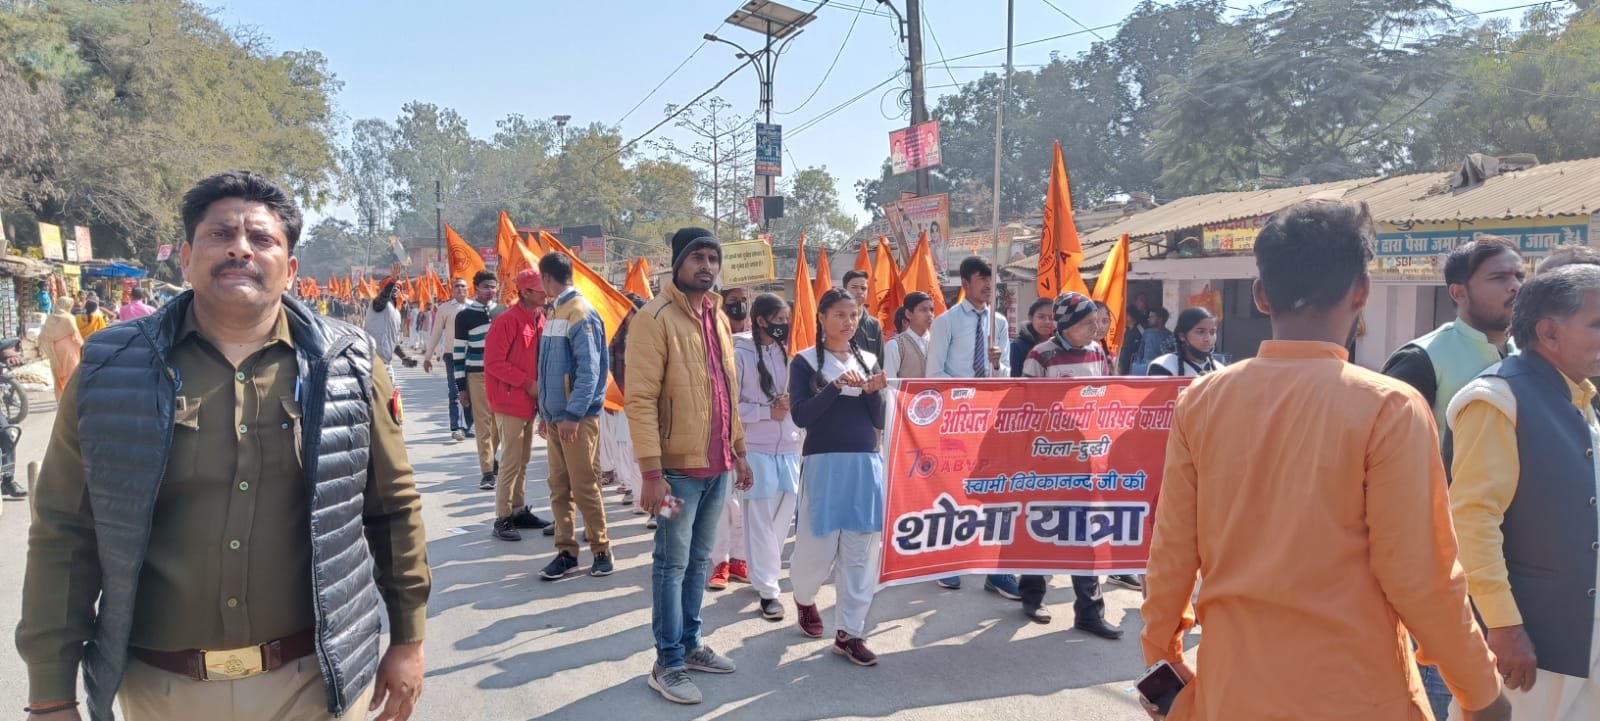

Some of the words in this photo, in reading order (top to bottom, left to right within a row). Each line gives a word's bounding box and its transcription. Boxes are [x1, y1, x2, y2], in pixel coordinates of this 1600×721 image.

[1405, 234, 1429, 252] पैसा
[1431, 238, 1457, 251] जमा
[1525, 233, 1560, 249] जाता
[1395, 256, 1412, 267] SBI
[941, 404, 991, 433] अखिल
[995, 403, 1046, 431] भारतीय
[1098, 401, 1137, 428] परिषद
[1140, 401, 1175, 429] काशी
[965, 475, 1007, 493] स्वामी
[1010, 473, 1092, 491] विवेकानन्द
[1097, 471, 1118, 490] जी
[1122, 470, 1146, 490] की
[897, 496, 1018, 550] शोभा
[1028, 505, 1146, 543] यात्रा
